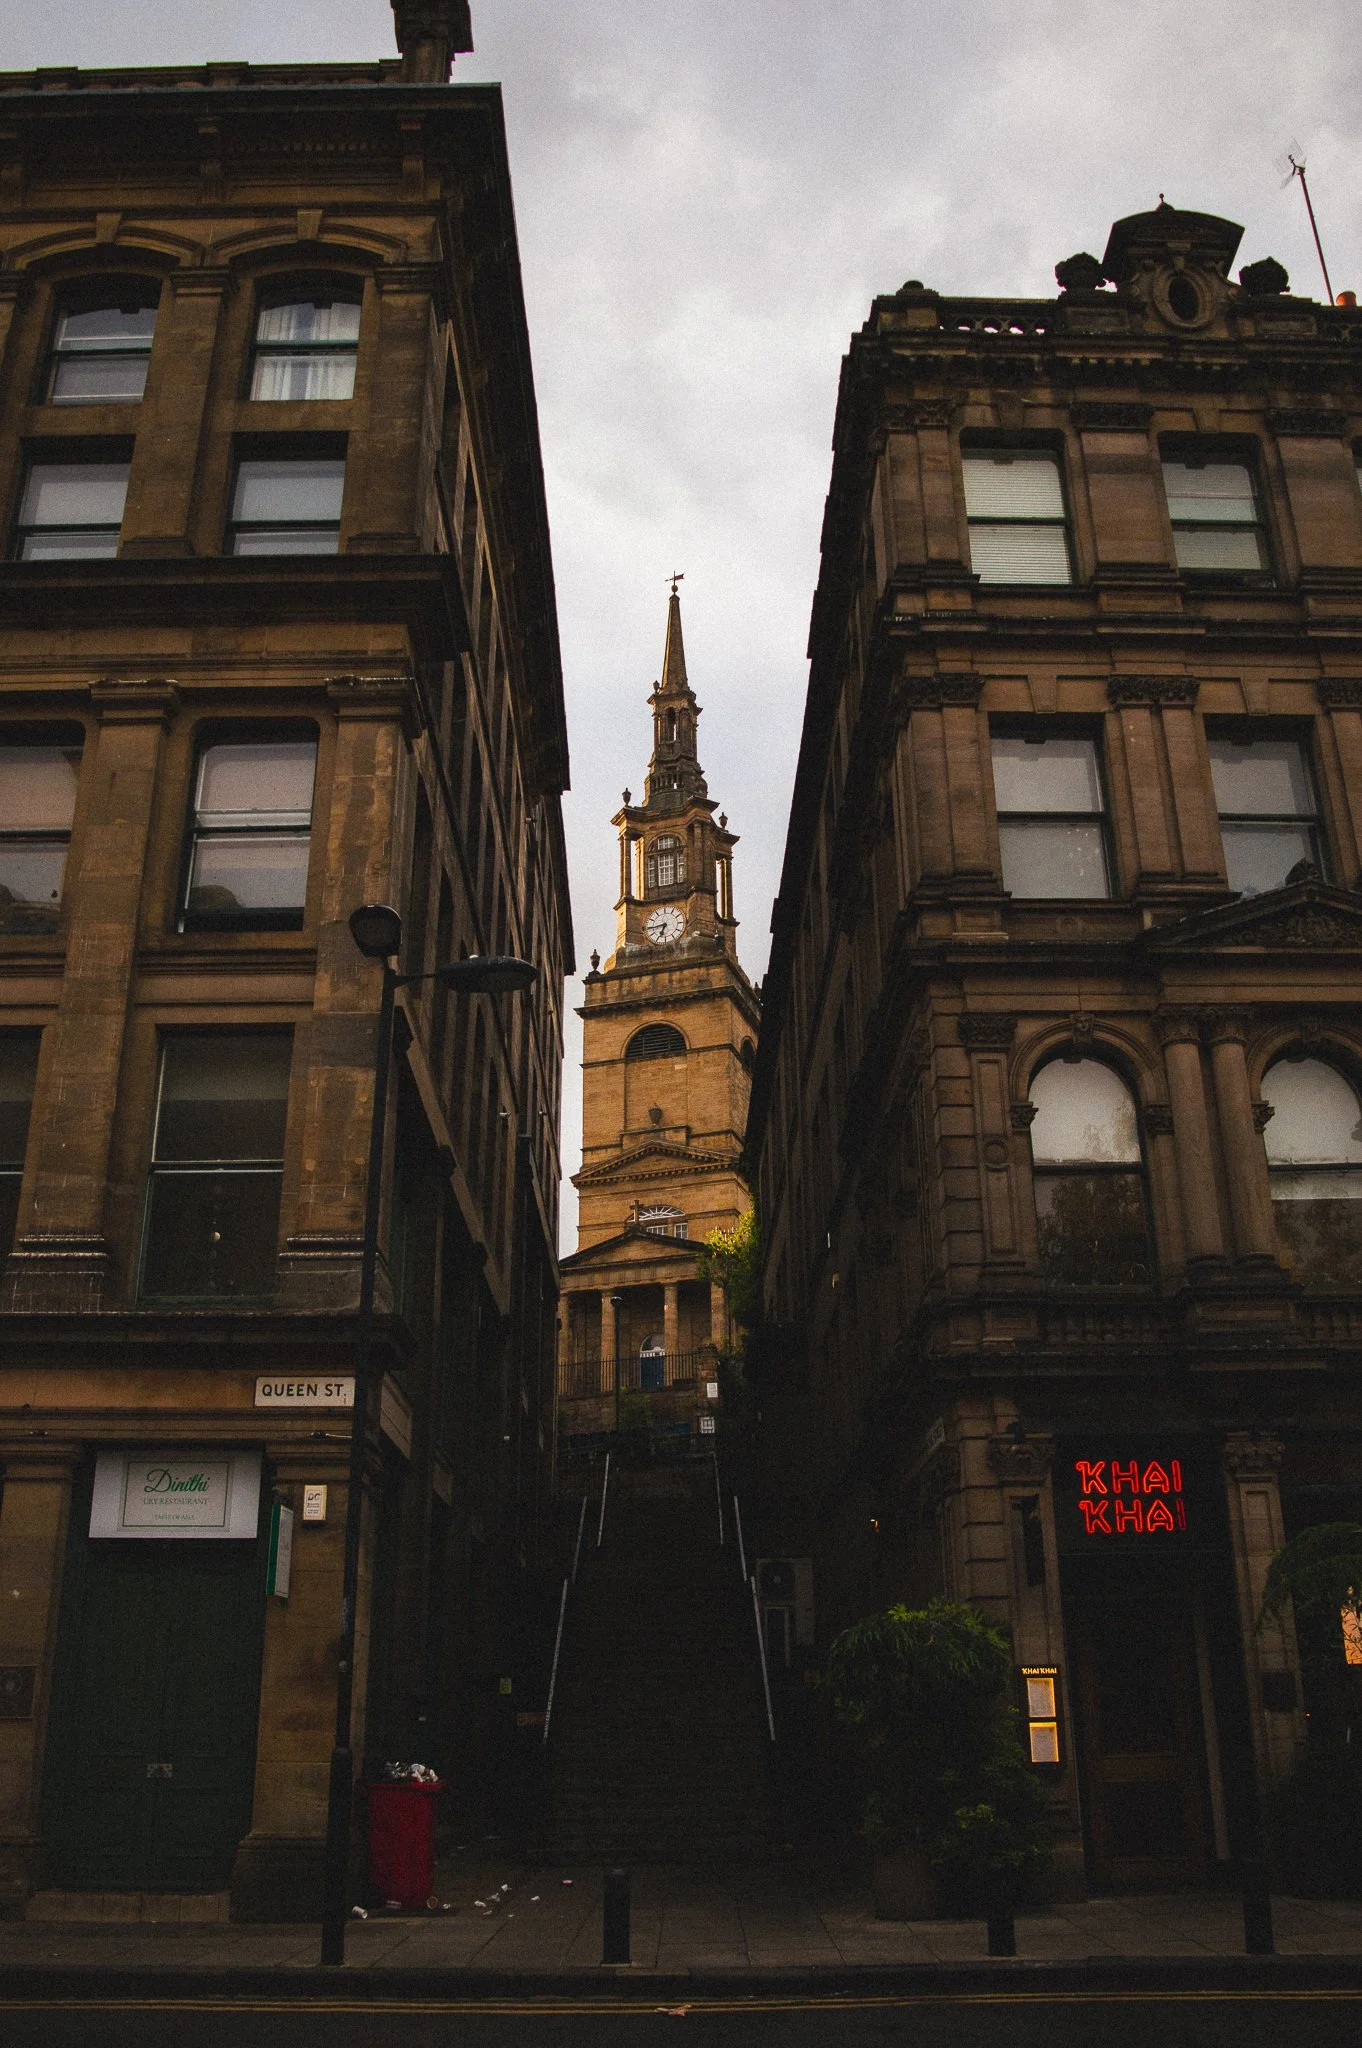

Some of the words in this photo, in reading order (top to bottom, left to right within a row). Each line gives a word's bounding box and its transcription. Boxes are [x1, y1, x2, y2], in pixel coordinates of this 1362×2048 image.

[262, 1383, 318, 1398] QUEEN
[325, 1383, 347, 1397] ST.
[144, 1468, 211, 1493] Dinithi
[1075, 1459, 1182, 1494] KHAI
[159, 1497, 209, 1505] RESTAURANT
[1078, 1498, 1186, 1534] KHAI
